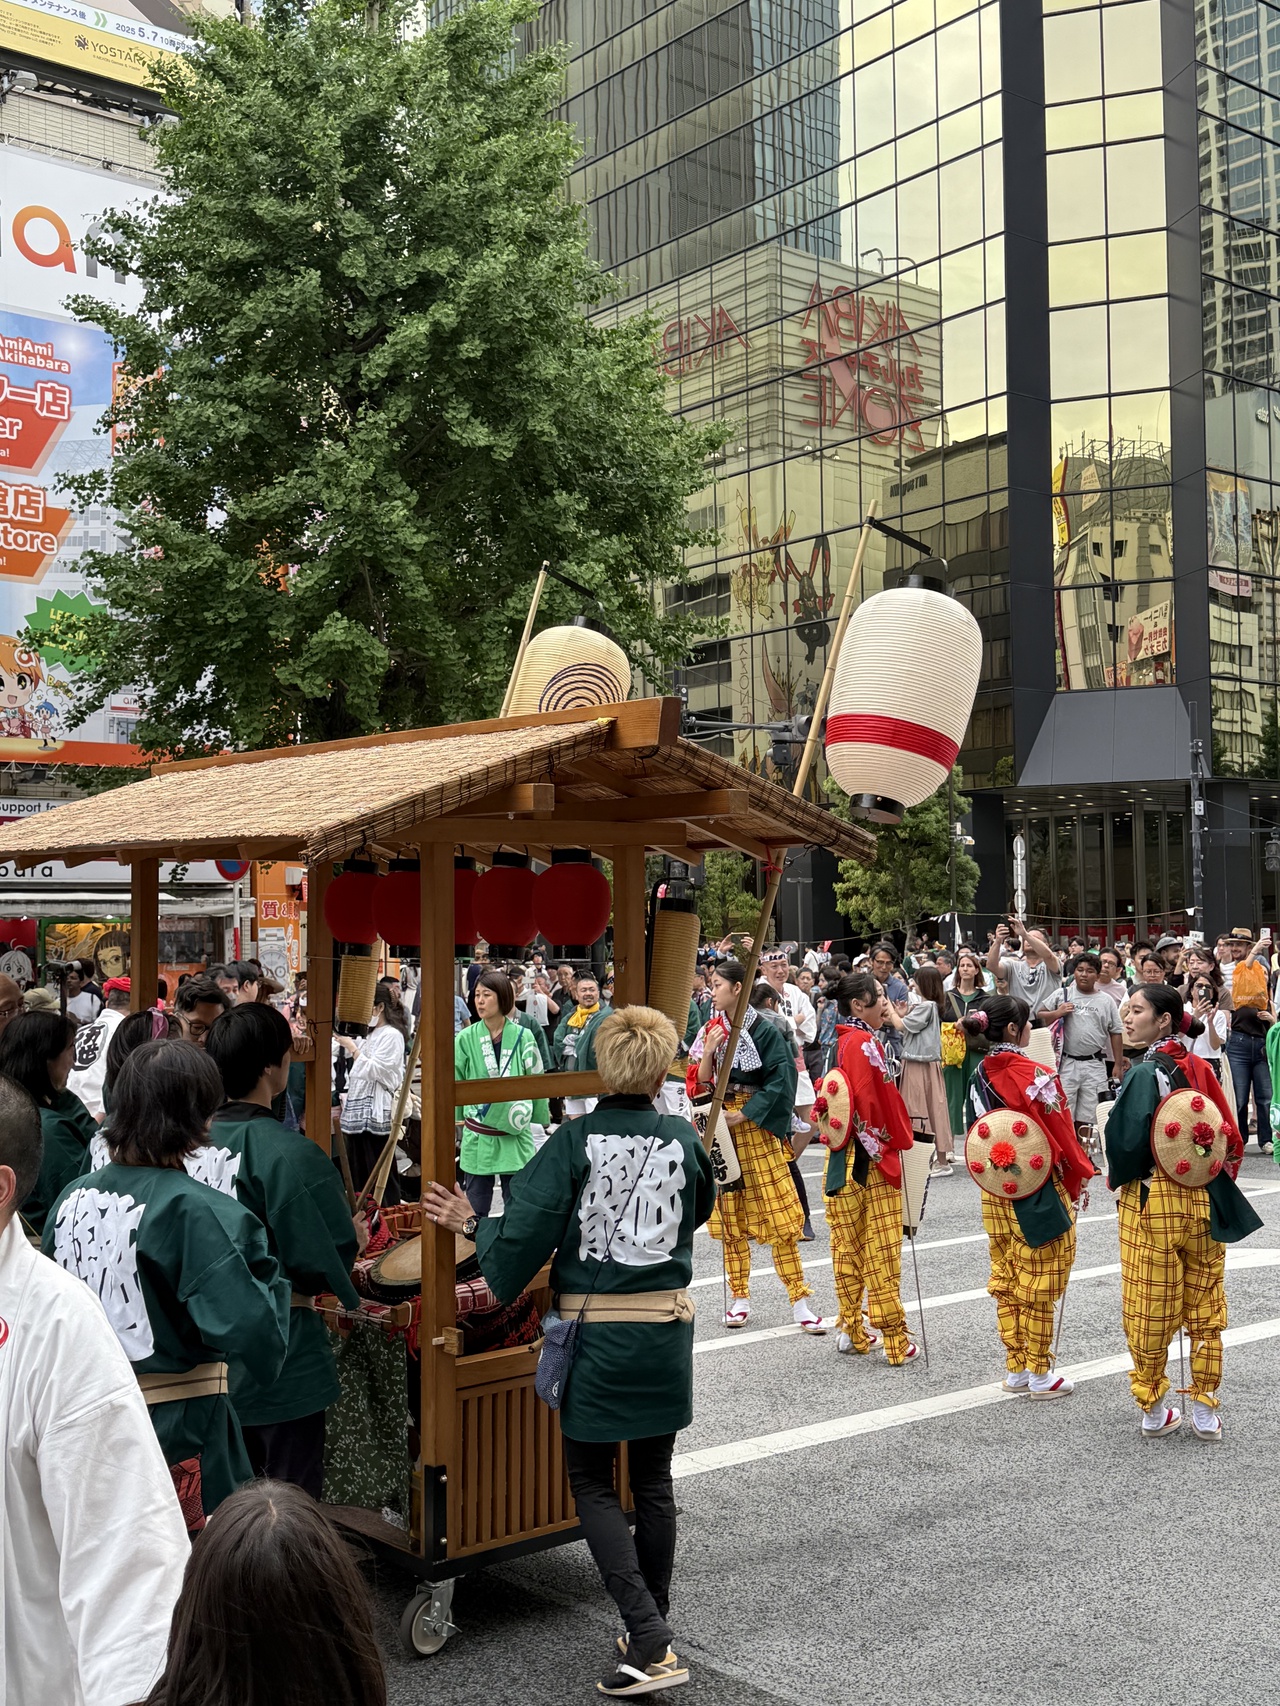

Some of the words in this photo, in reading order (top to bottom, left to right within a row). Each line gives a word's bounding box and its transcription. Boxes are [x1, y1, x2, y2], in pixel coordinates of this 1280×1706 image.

[21, 0, 87, 20] メンテナンス後
[115, 22, 136, 35] 2025
[138, 27, 159, 42] 5.7
[90, 40, 142, 65] YOSTAR
[0, 522, 58, 555] tore
[0, 802, 41, 815] upport
[1072, 1004, 1099, 1013] AUTICA
